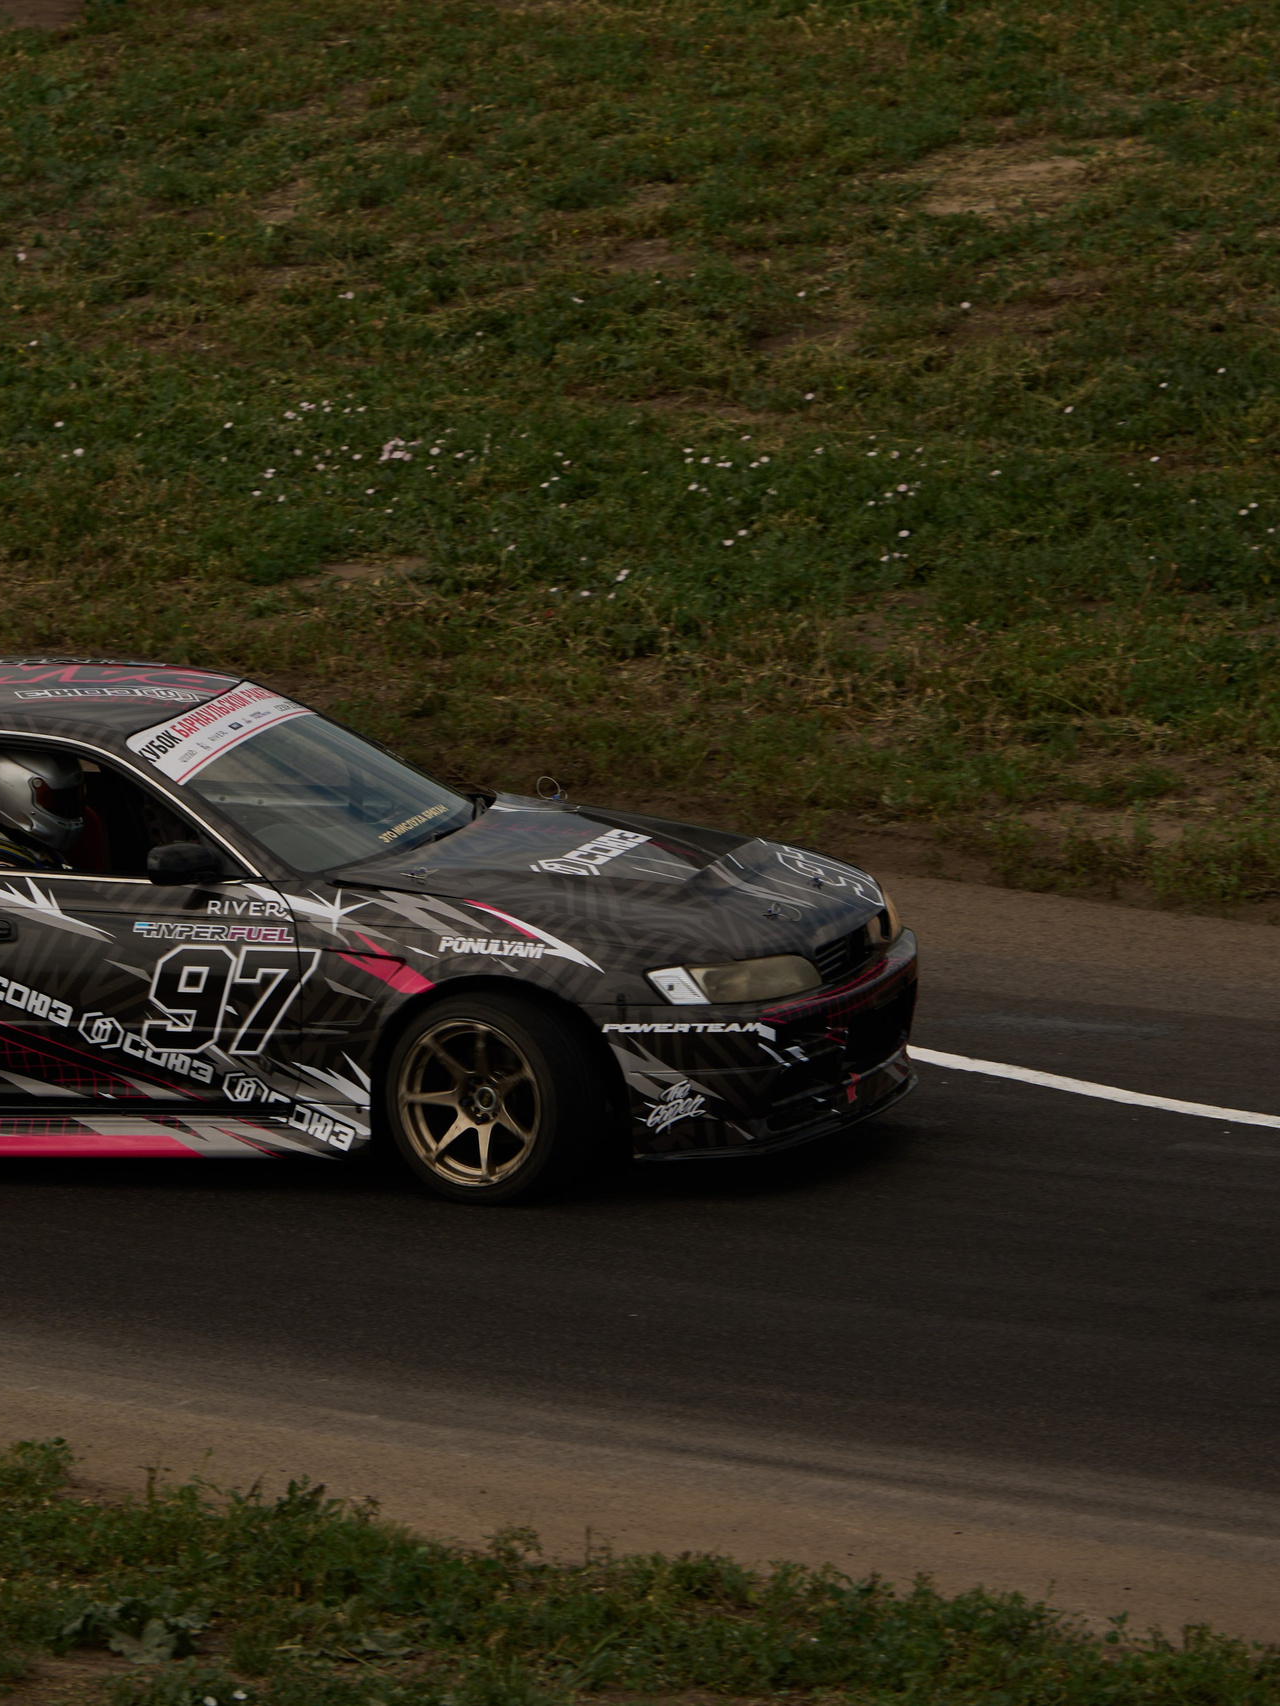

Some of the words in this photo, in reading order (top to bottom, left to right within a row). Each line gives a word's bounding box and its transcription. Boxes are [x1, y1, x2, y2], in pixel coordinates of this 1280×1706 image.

[138, 729, 183, 763] КУБОК
[169, 691, 252, 738] БАРНАУЛЬСКОЙ
[207, 900, 287, 918] RIVER
[438, 936, 546, 960] PONULYAM
[141, 943, 322, 1056] 97
